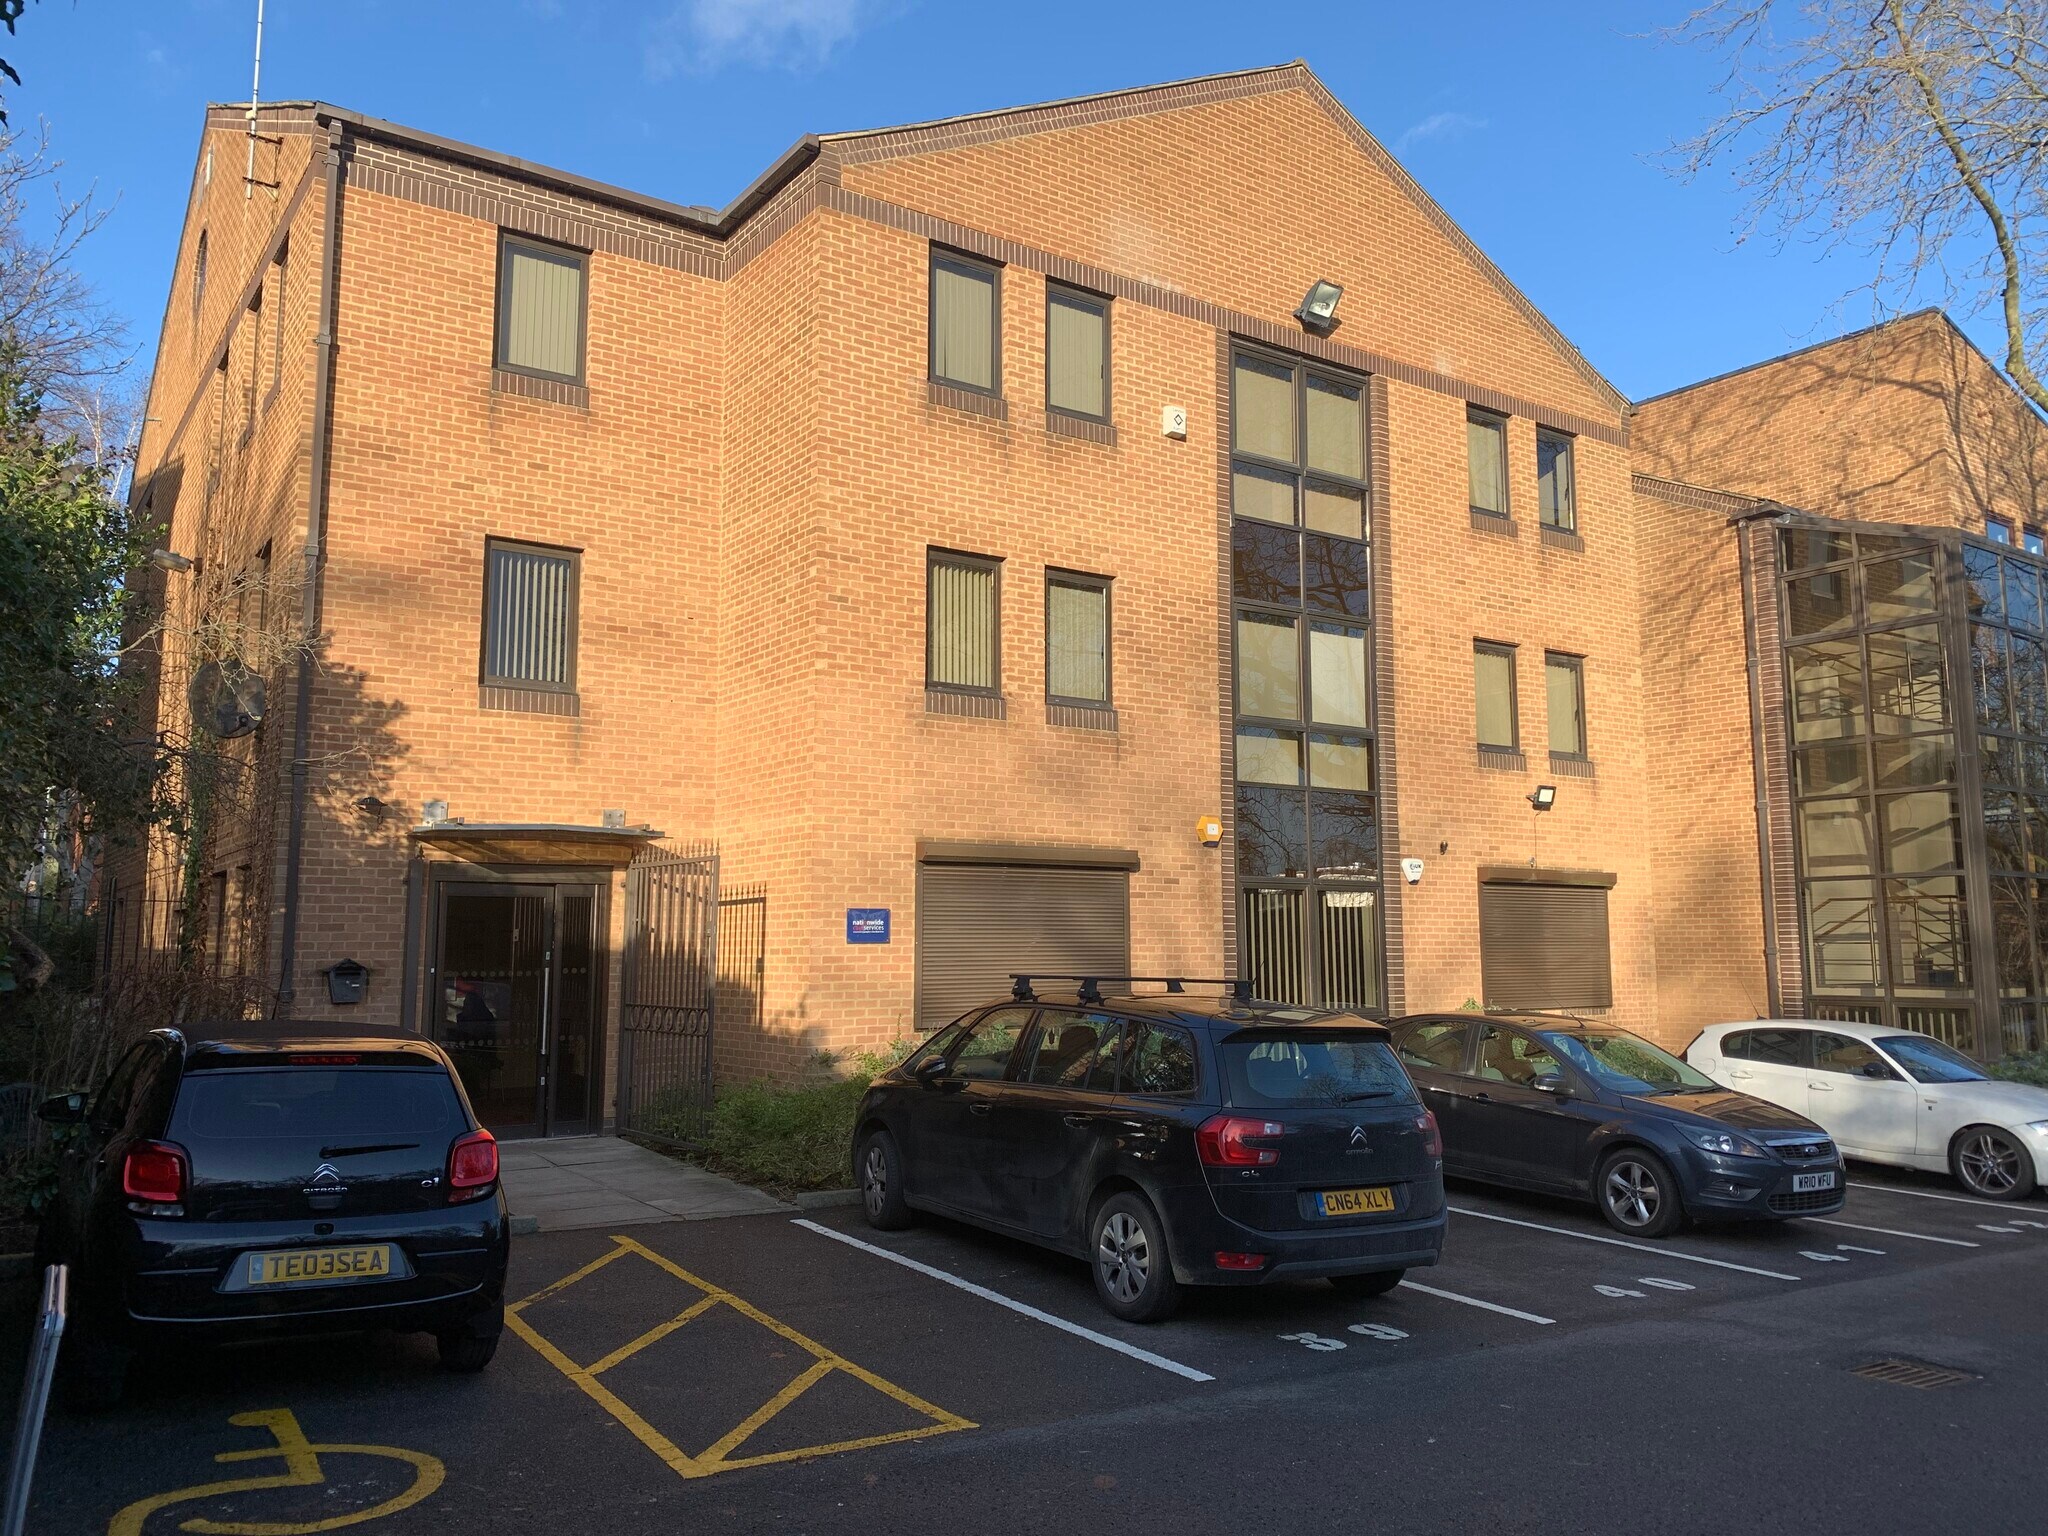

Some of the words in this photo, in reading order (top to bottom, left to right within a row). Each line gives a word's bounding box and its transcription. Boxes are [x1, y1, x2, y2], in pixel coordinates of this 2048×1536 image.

[1326, 1193, 1362, 1212] CN64
[1366, 1190, 1390, 1205] XLY
[1592, 1277, 1696, 1297] 40
[1276, 1323, 1410, 1351] 39
